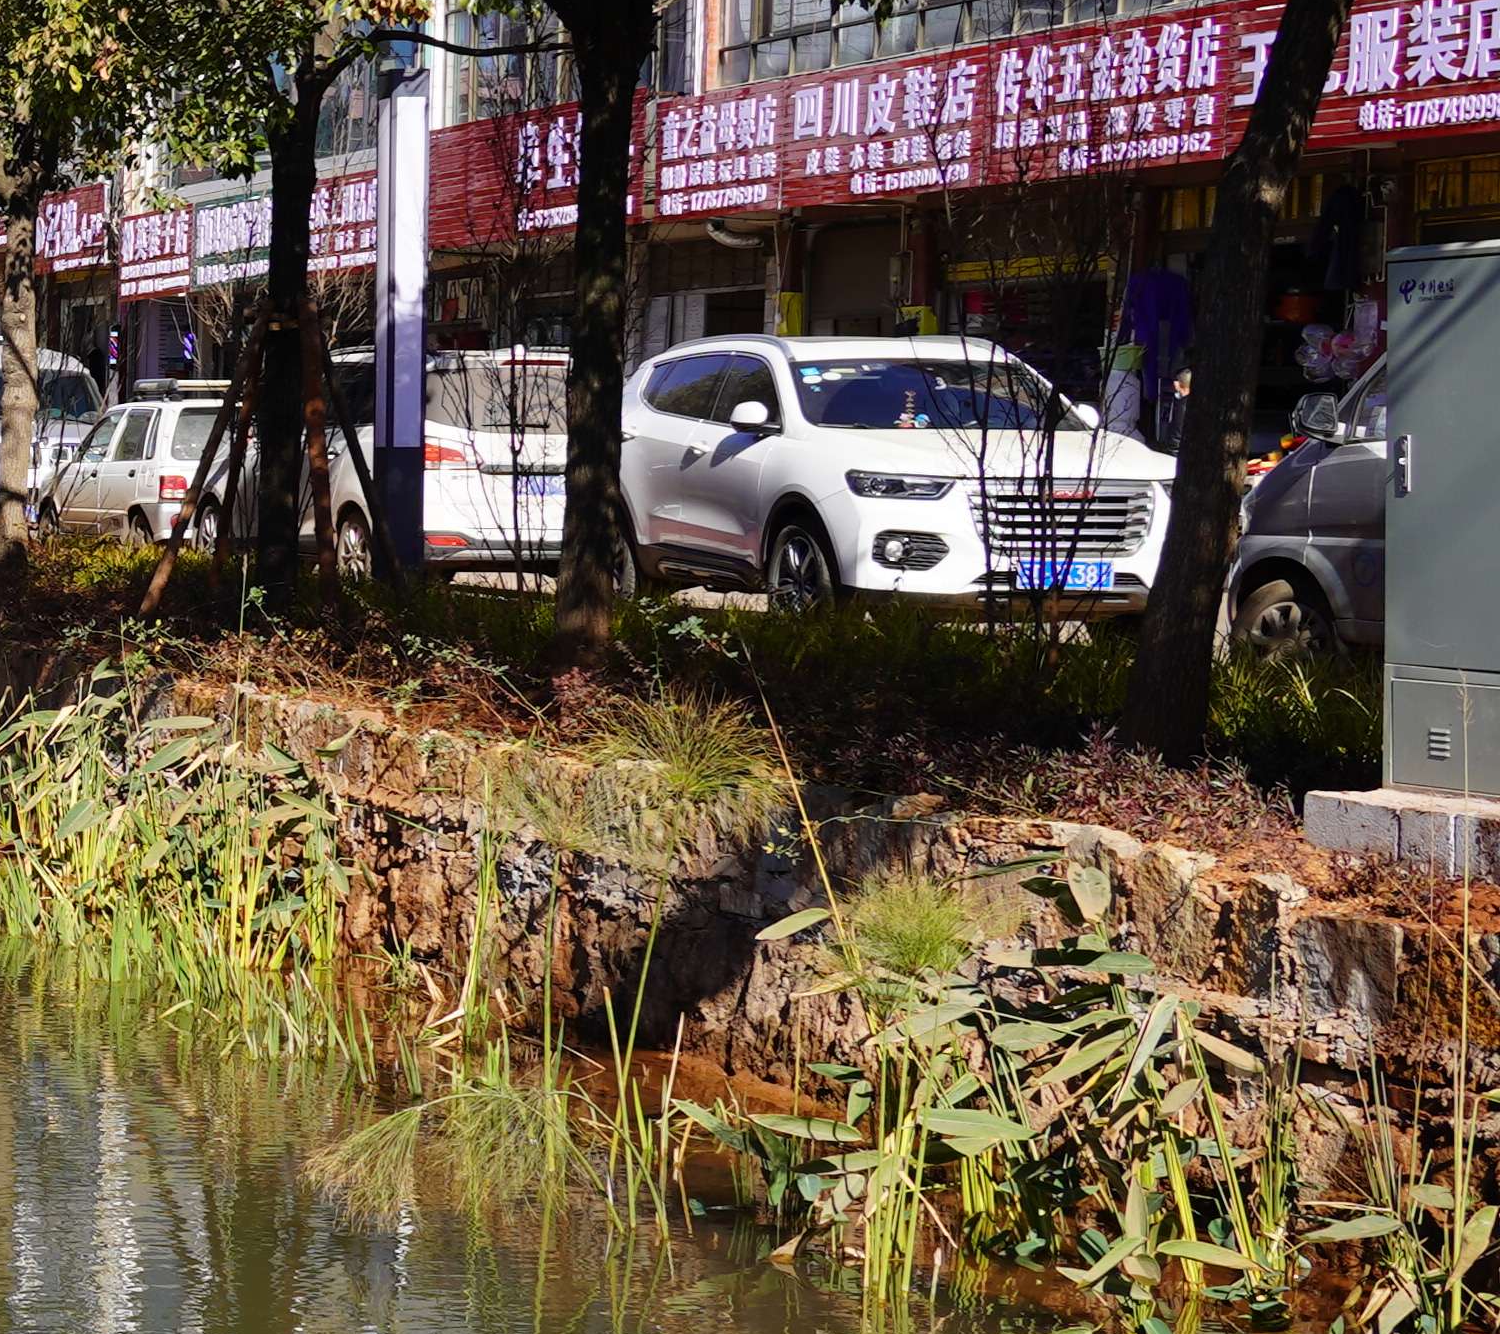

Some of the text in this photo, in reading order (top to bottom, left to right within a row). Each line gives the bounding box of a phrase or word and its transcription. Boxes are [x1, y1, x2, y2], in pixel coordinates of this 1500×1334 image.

[794, 59, 978, 141] 四川皮鞋店
[996, 17, 1222, 116] 传华五金杂货店
[660, 94, 778, 162] 童之益母婴店
[1419, 278, 1455, 296] 中国电信
